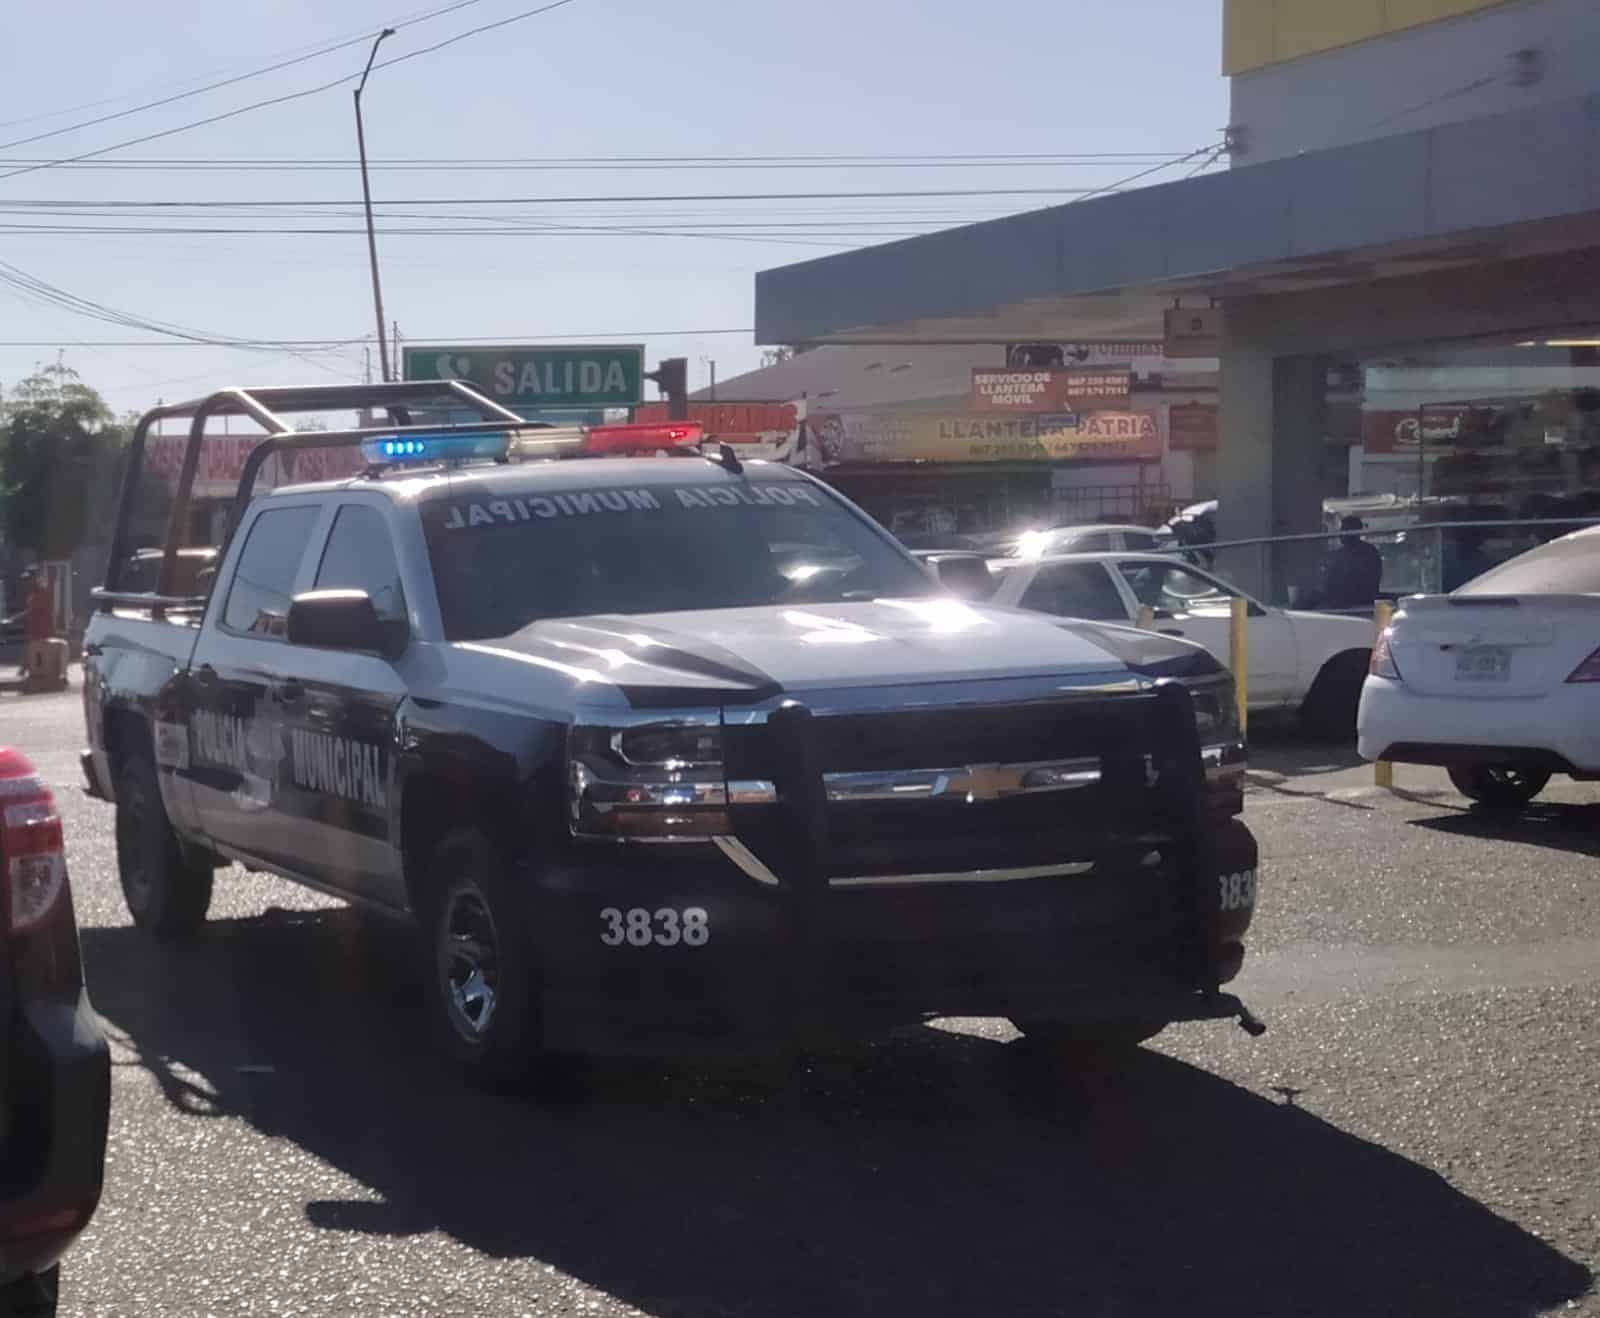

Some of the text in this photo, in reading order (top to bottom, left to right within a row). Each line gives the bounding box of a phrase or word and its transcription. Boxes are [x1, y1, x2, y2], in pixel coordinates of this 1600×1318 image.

[494, 359, 627, 395] SALIDA
[975, 371, 1051, 385] SERVICIO DE
[1075, 418, 1154, 436] PATRIA
[291, 727, 386, 808] MUNICIPAL
[599, 907, 709, 946] 3838
